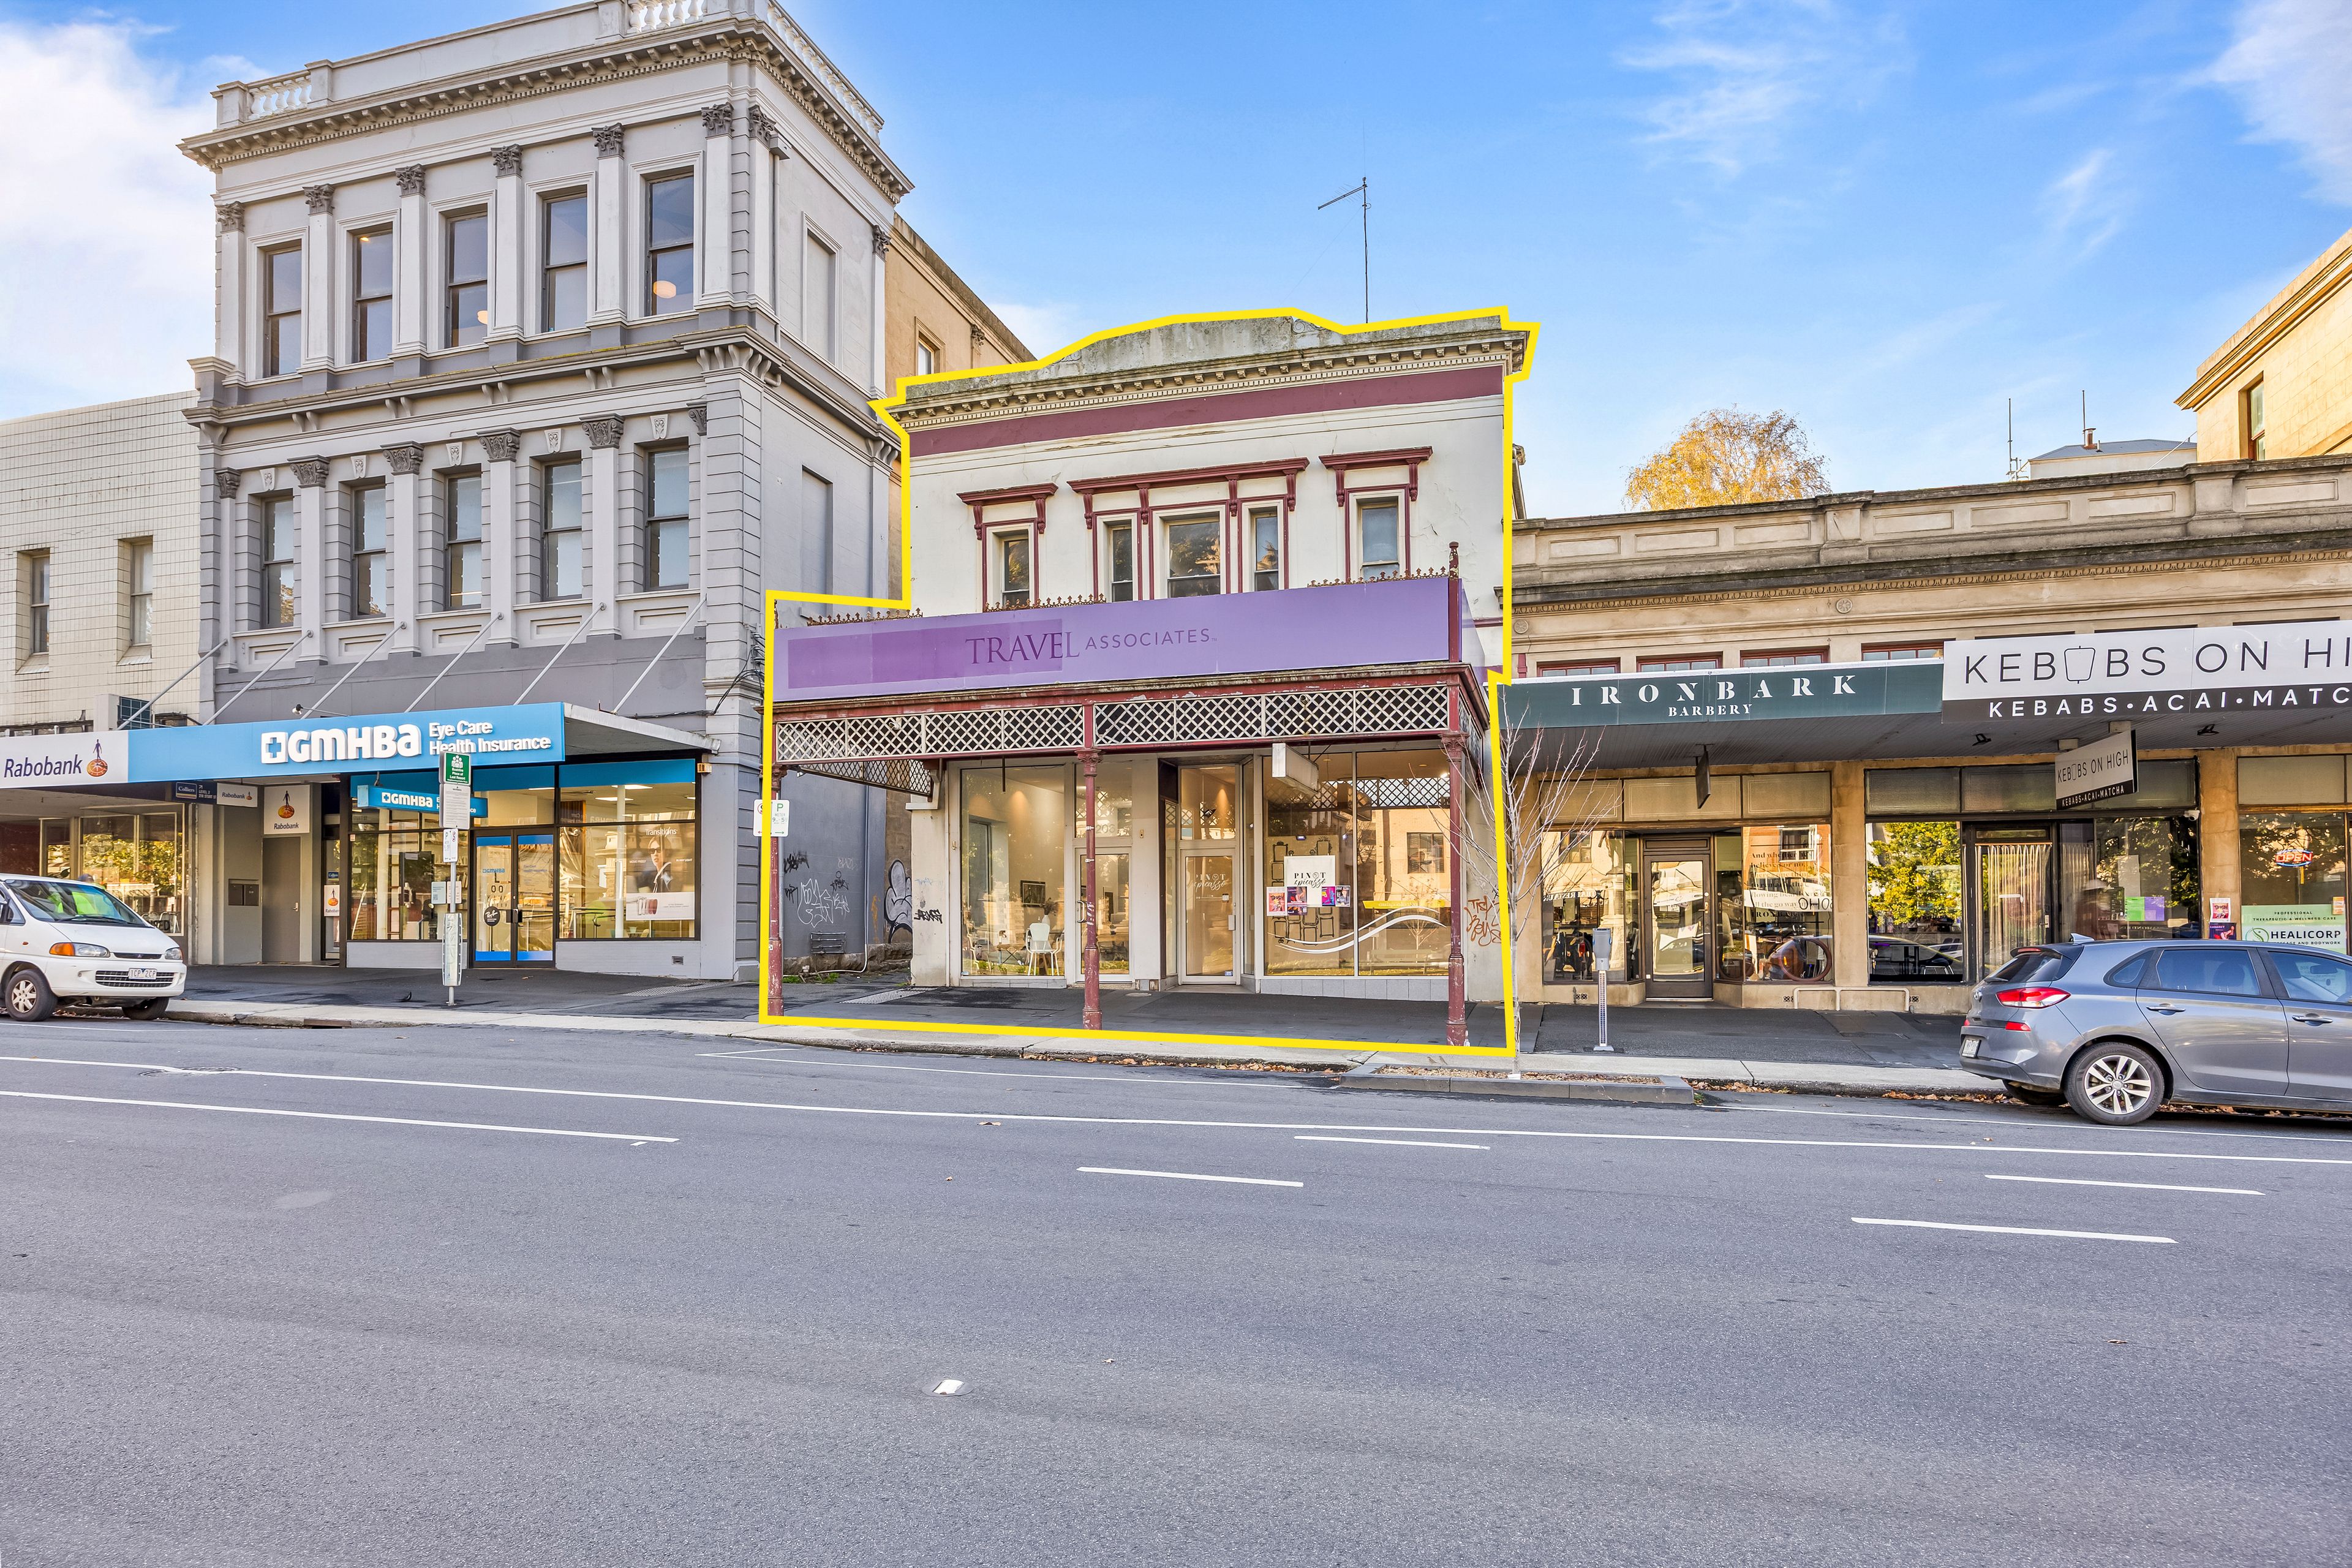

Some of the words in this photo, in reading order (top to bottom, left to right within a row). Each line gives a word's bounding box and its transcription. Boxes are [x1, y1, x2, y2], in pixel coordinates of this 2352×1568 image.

[965, 631, 1080, 665] TRAVEL
[1085, 628, 1210, 649] ASSOCIATES
[2195, 641, 2268, 673] ON
[1571, 675, 1856, 706] IRONBARK
[1668, 704, 1752, 717] BARBERY
[429, 722, 456, 737] Eye
[456, 720, 493, 734] Care
[429, 736, 477, 755] Health
[478, 736, 551, 753] Insurance
[4, 754, 83, 778] Rabobank
[2091, 757, 2103, 774] ON
[2107, 749, 2128, 770] HIGH
[777, 803, 783, 812] P
[2275, 853, 2312, 862] OPEN
[2271, 930, 2342, 939] HEALICORP
